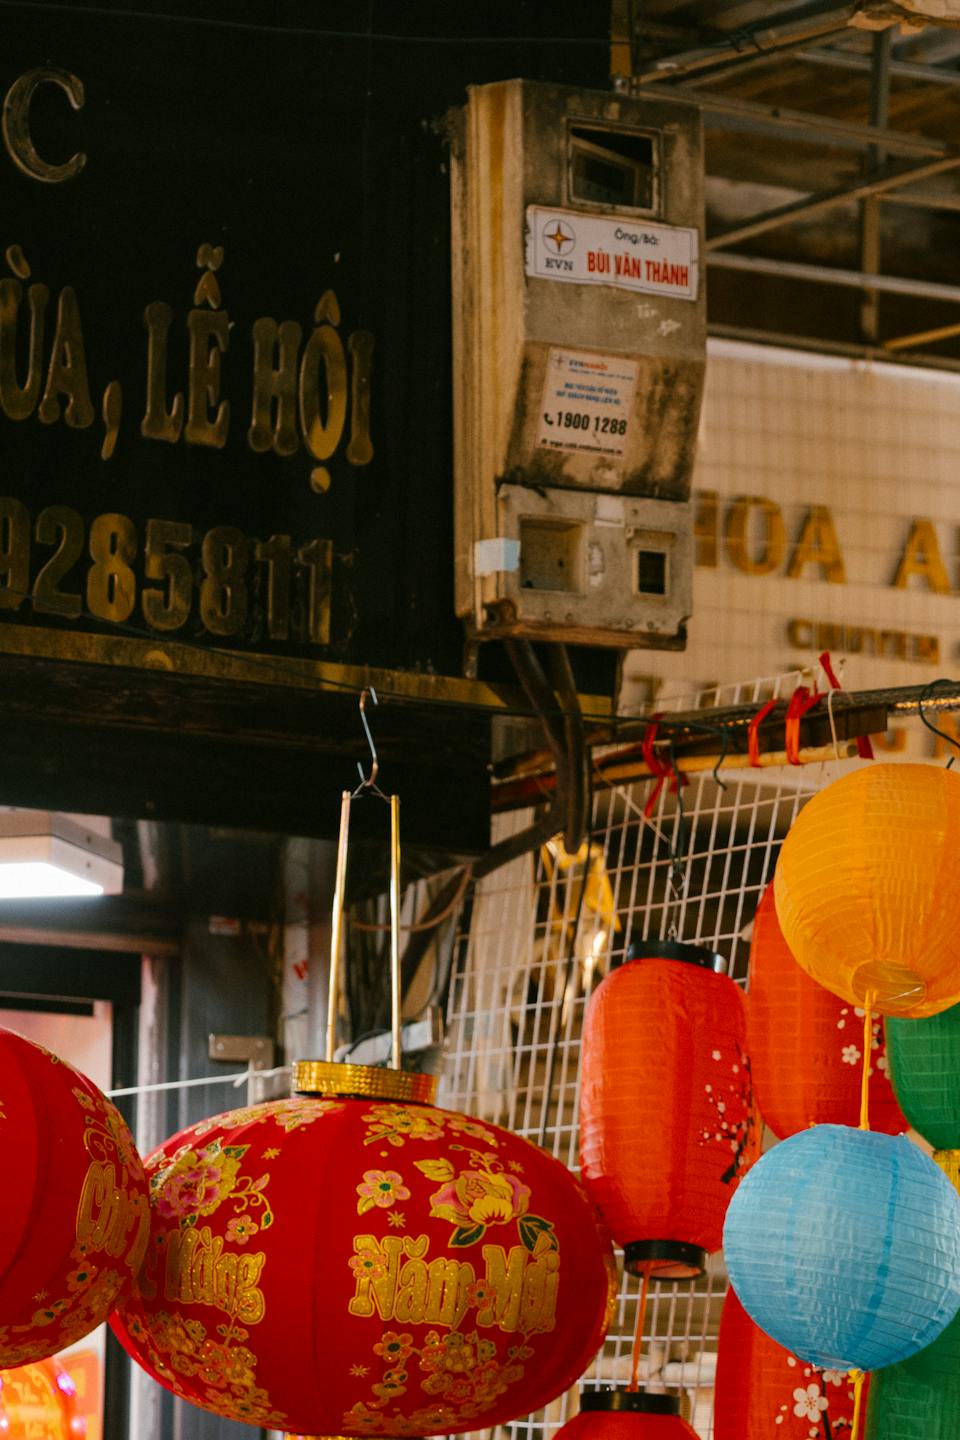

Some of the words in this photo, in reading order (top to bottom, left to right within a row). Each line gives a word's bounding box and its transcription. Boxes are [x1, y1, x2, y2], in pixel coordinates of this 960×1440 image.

[2, 66, 87, 182] C
[545, 256, 574, 272] EVN
[586, 248, 611, 274] BÙI
[141, 243, 231, 450] LỄ
[248, 289, 375, 494] HỘI
[557, 410, 591, 431] 1900
[594, 415, 628, 436] 1288
[348, 1234, 476, 1330] Năm
